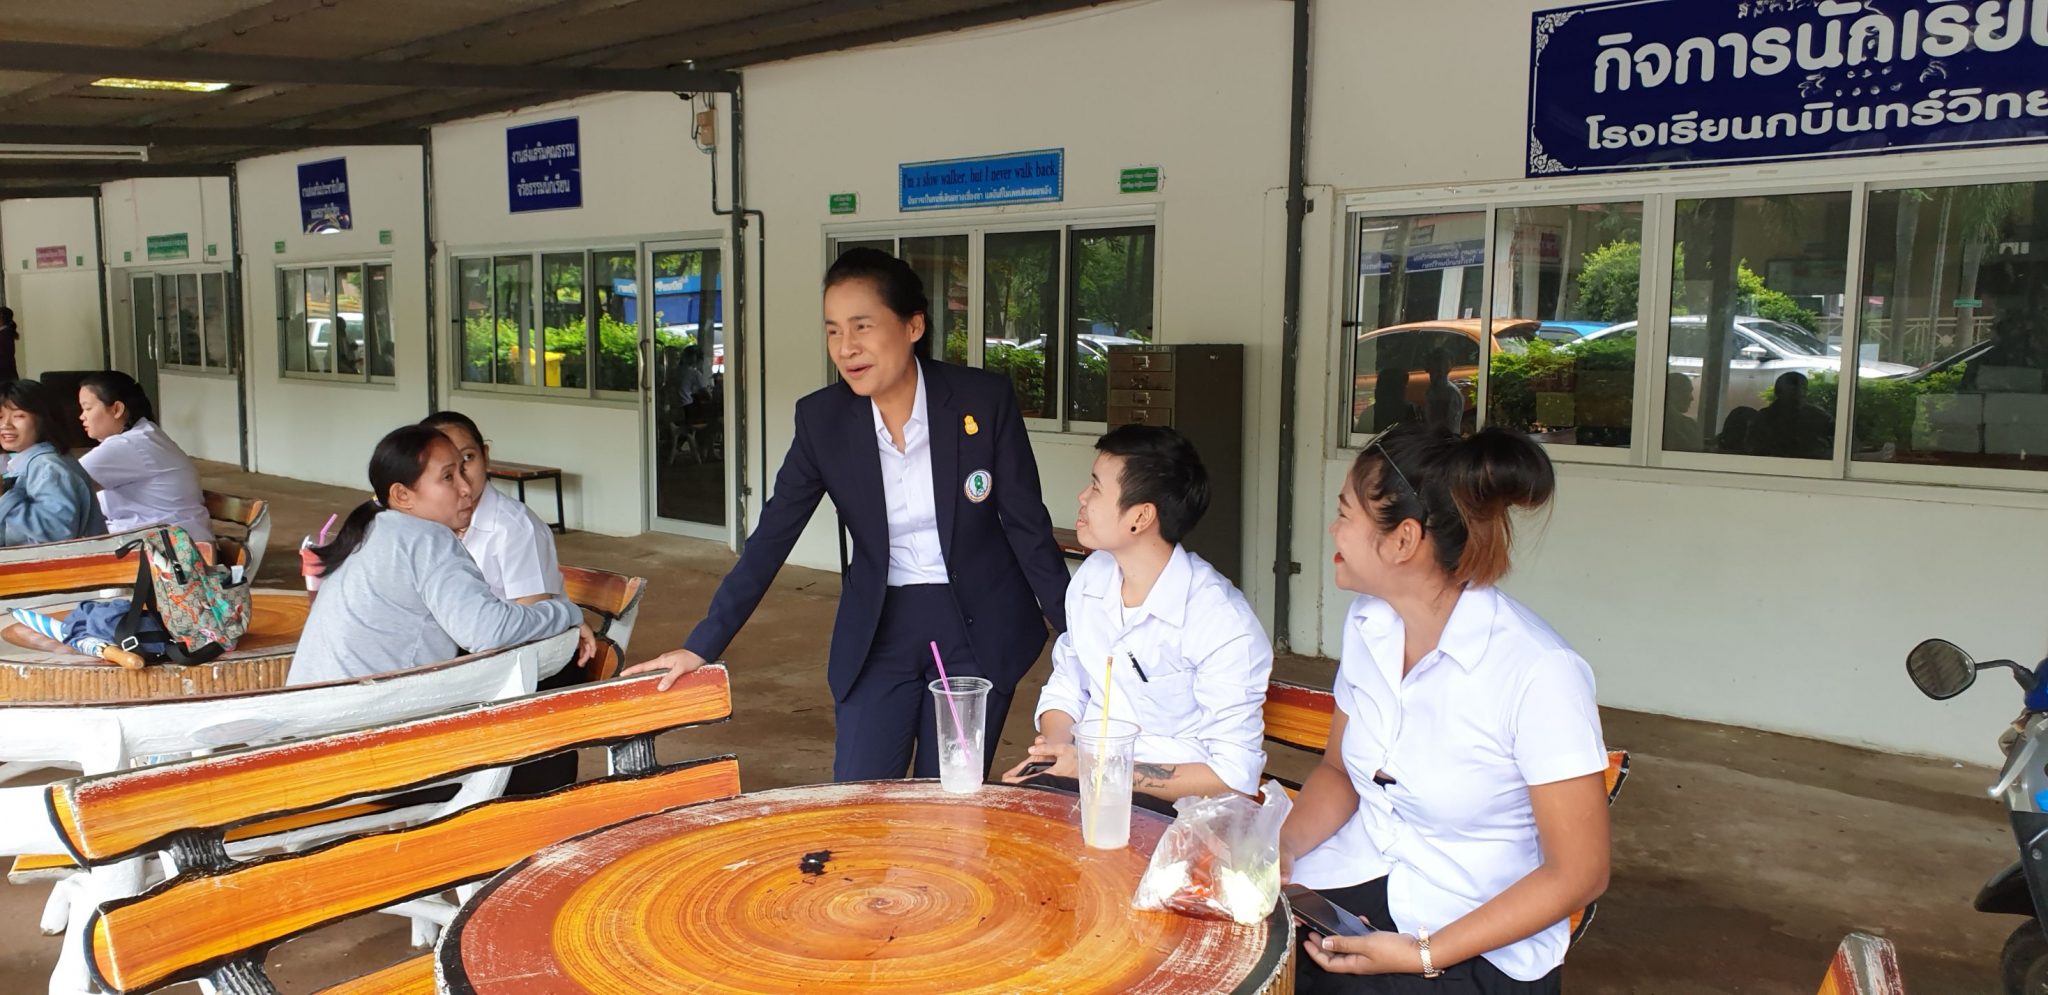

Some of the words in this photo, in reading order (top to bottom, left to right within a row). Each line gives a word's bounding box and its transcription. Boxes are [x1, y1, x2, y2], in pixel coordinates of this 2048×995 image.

[923, 172, 937, 186] slow
[970, 168, 982, 182] but
[991, 167, 1011, 181] never
[1015, 162, 1032, 178] walk
